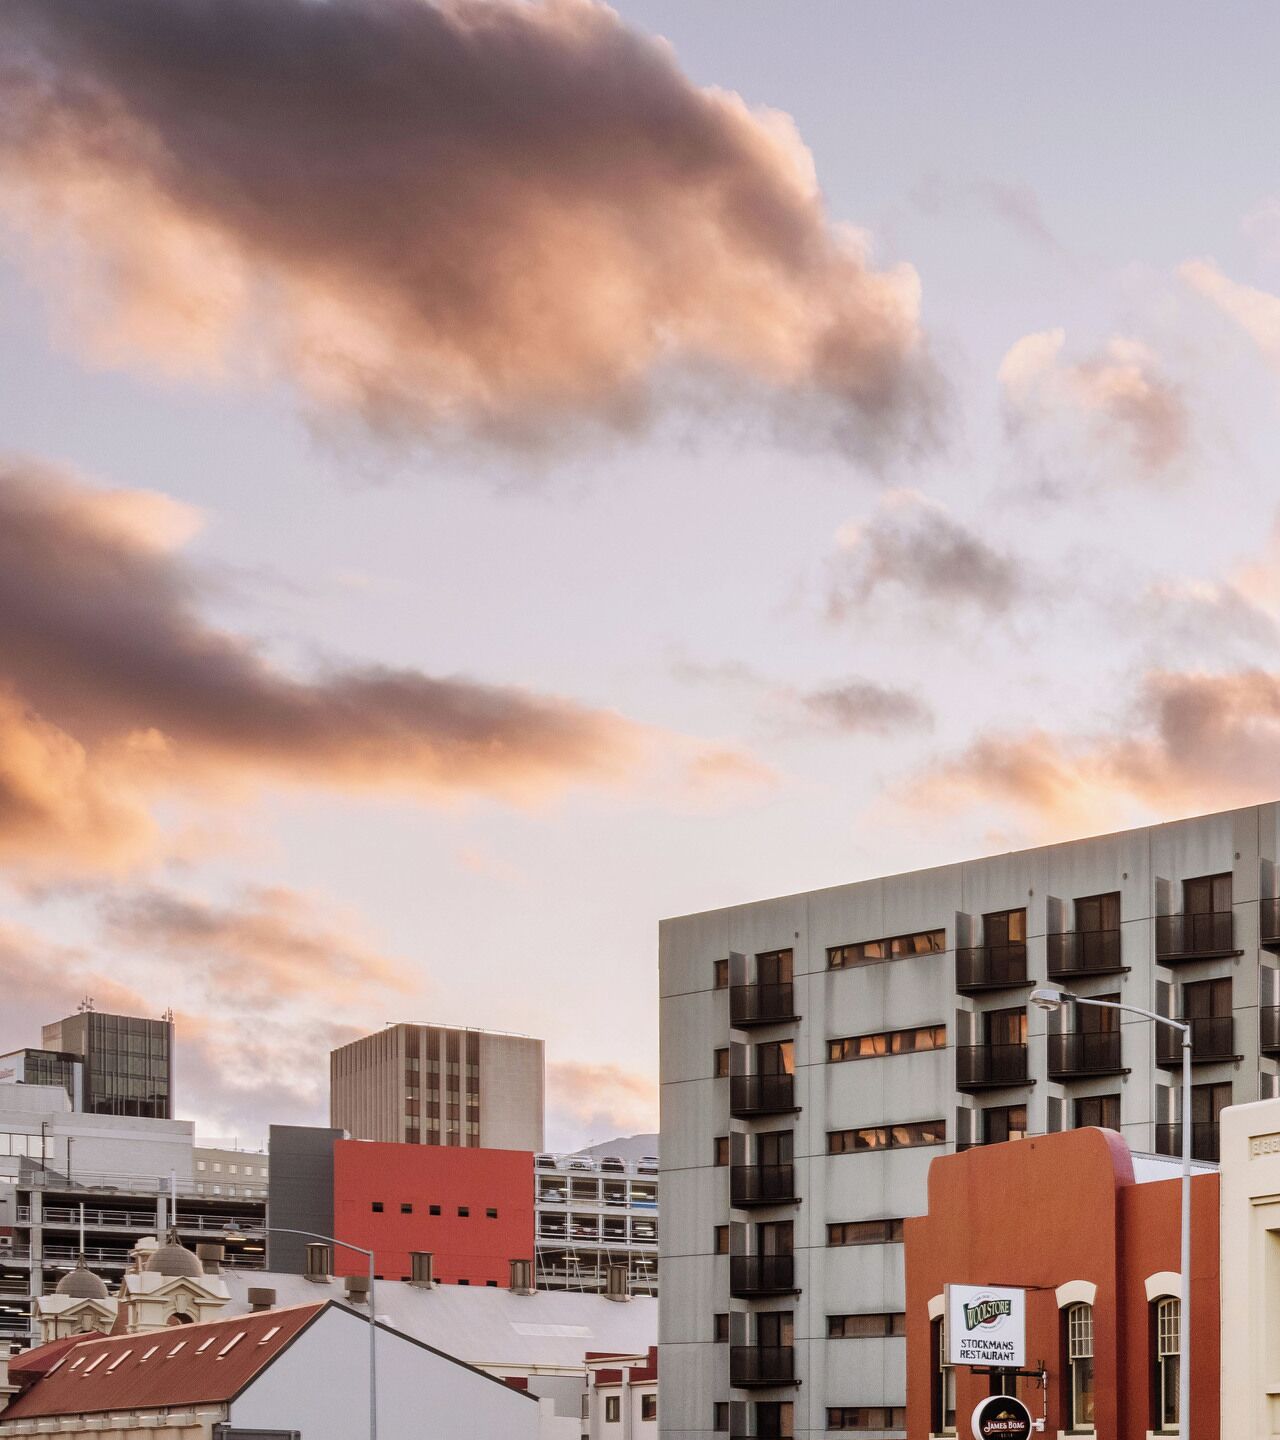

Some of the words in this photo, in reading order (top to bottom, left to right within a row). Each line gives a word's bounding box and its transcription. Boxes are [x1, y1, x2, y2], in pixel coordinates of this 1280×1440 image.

[967, 1301, 1010, 1329] WOOLSTORE
[960, 1339, 1014, 1350] STOCKMANS
[960, 1350, 1015, 1361] RESTAURANT
